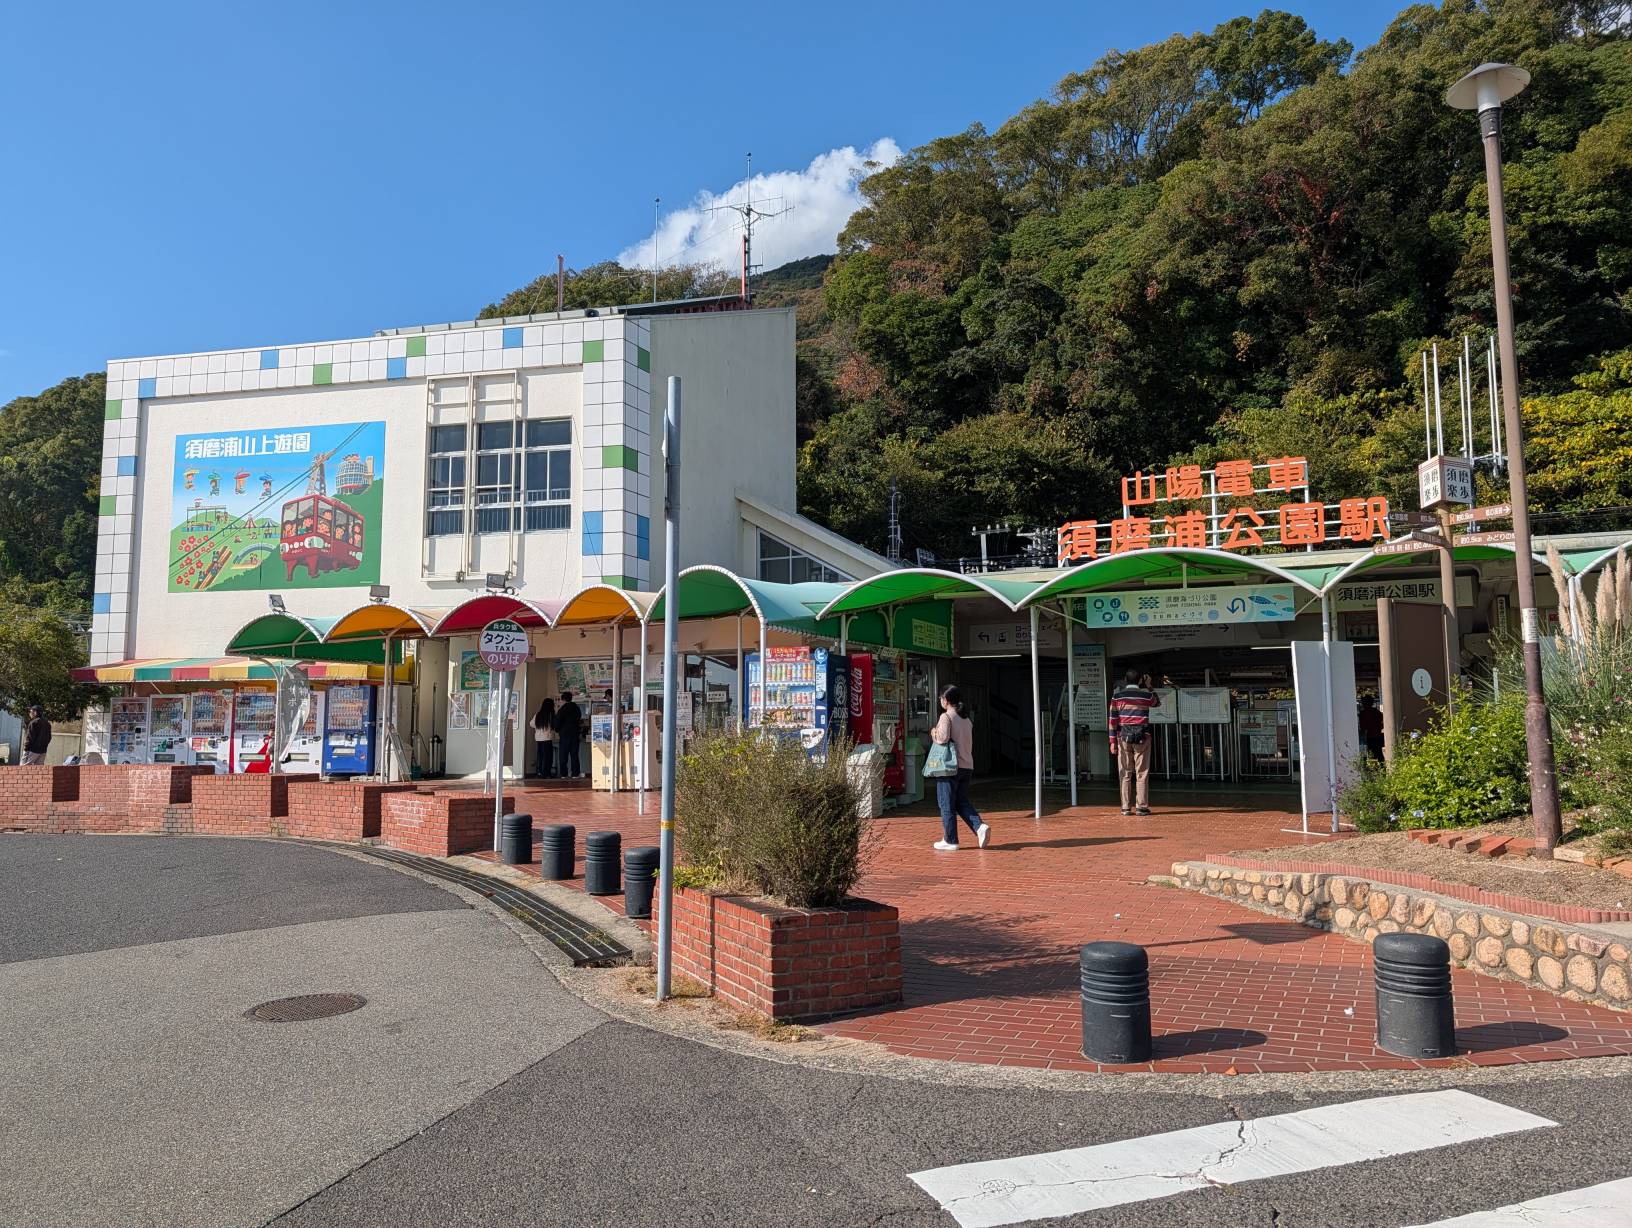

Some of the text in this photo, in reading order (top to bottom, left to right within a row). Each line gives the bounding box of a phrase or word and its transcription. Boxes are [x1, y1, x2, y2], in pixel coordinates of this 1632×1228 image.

[185, 432, 311, 459] 須磨浦山上遊園
[1121, 456, 1309, 506] 山陽電車
[1423, 468, 1438, 486] 須磨
[1446, 467, 1469, 484] 須磨
[1447, 484, 1470, 499] 楽歩
[1057, 496, 1390, 560] 須磨浦公園駅
[1338, 583, 1435, 601] 須磨浦公園駅
[484, 632, 525, 645] タクシー
[487, 653, 519, 666] のりば
[833, 707, 848, 719] BOSS
